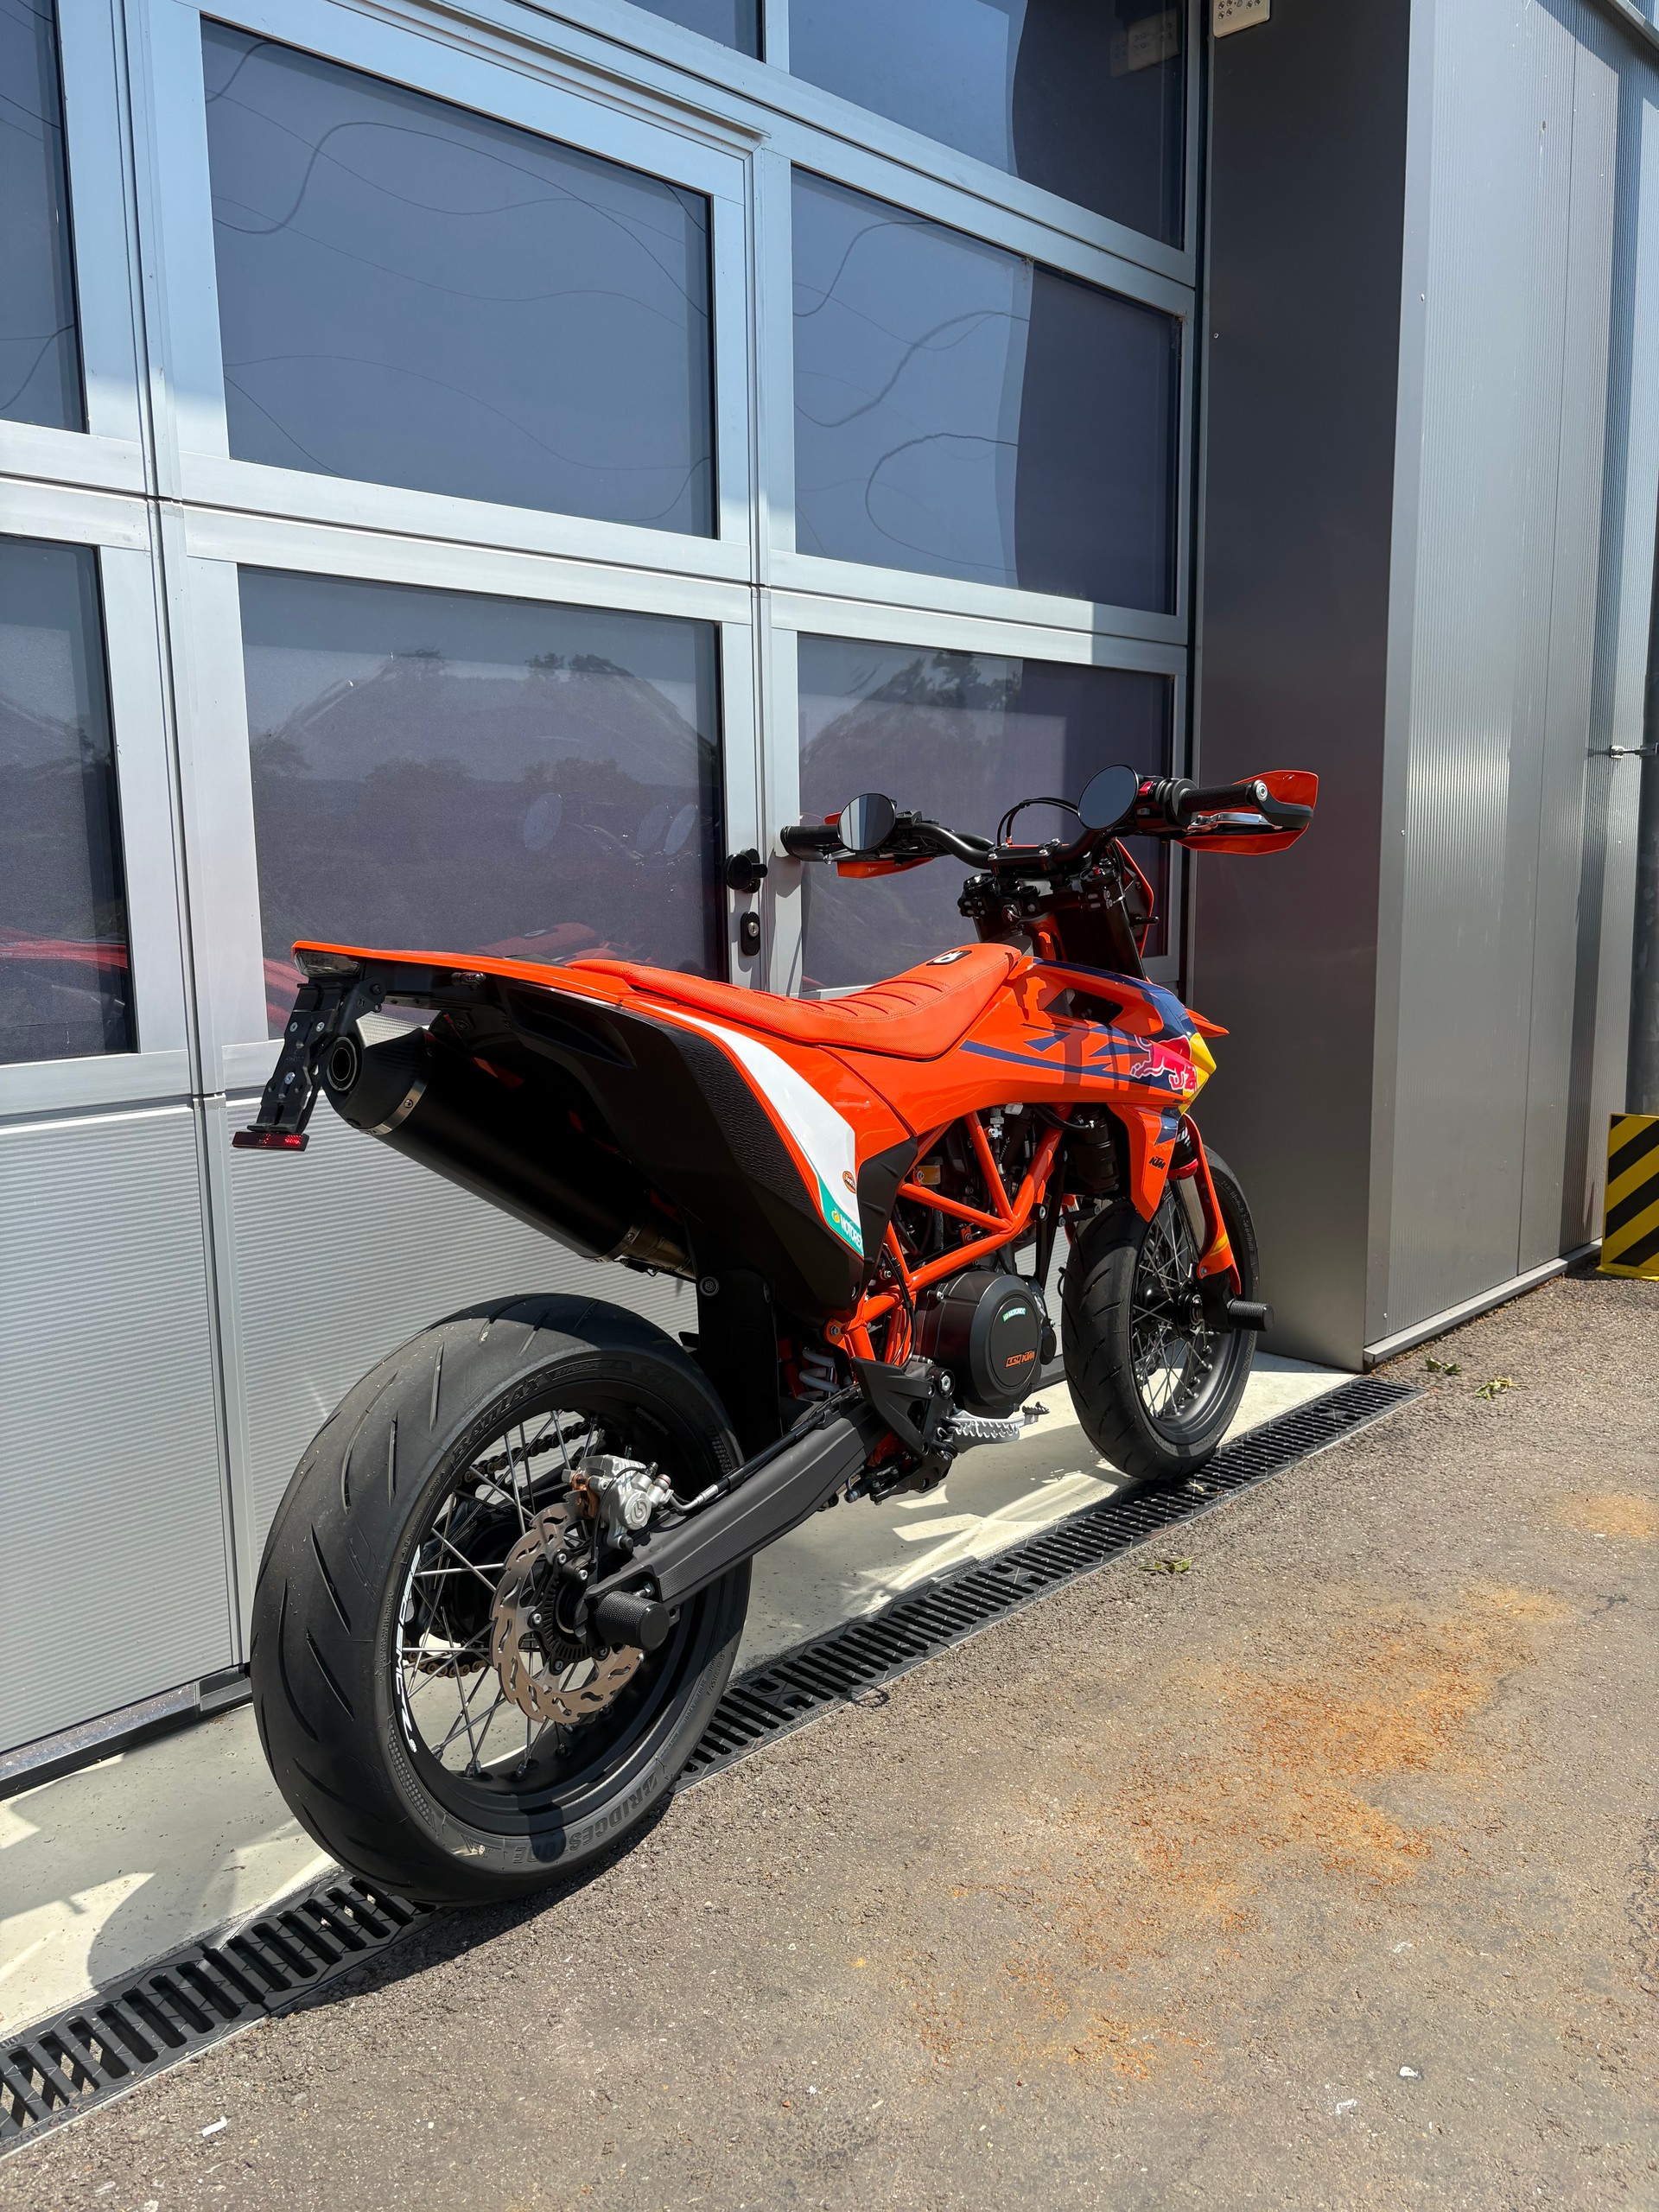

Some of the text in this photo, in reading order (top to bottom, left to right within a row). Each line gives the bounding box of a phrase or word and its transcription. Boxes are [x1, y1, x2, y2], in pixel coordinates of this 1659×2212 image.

[1148, 1155, 1166, 1170] KTM
[1021, 1351, 1035, 1363] KTM
[452, 1373, 543, 1462] BATTLAX
[512, 1770, 660, 1866] BRIDGESTONE
